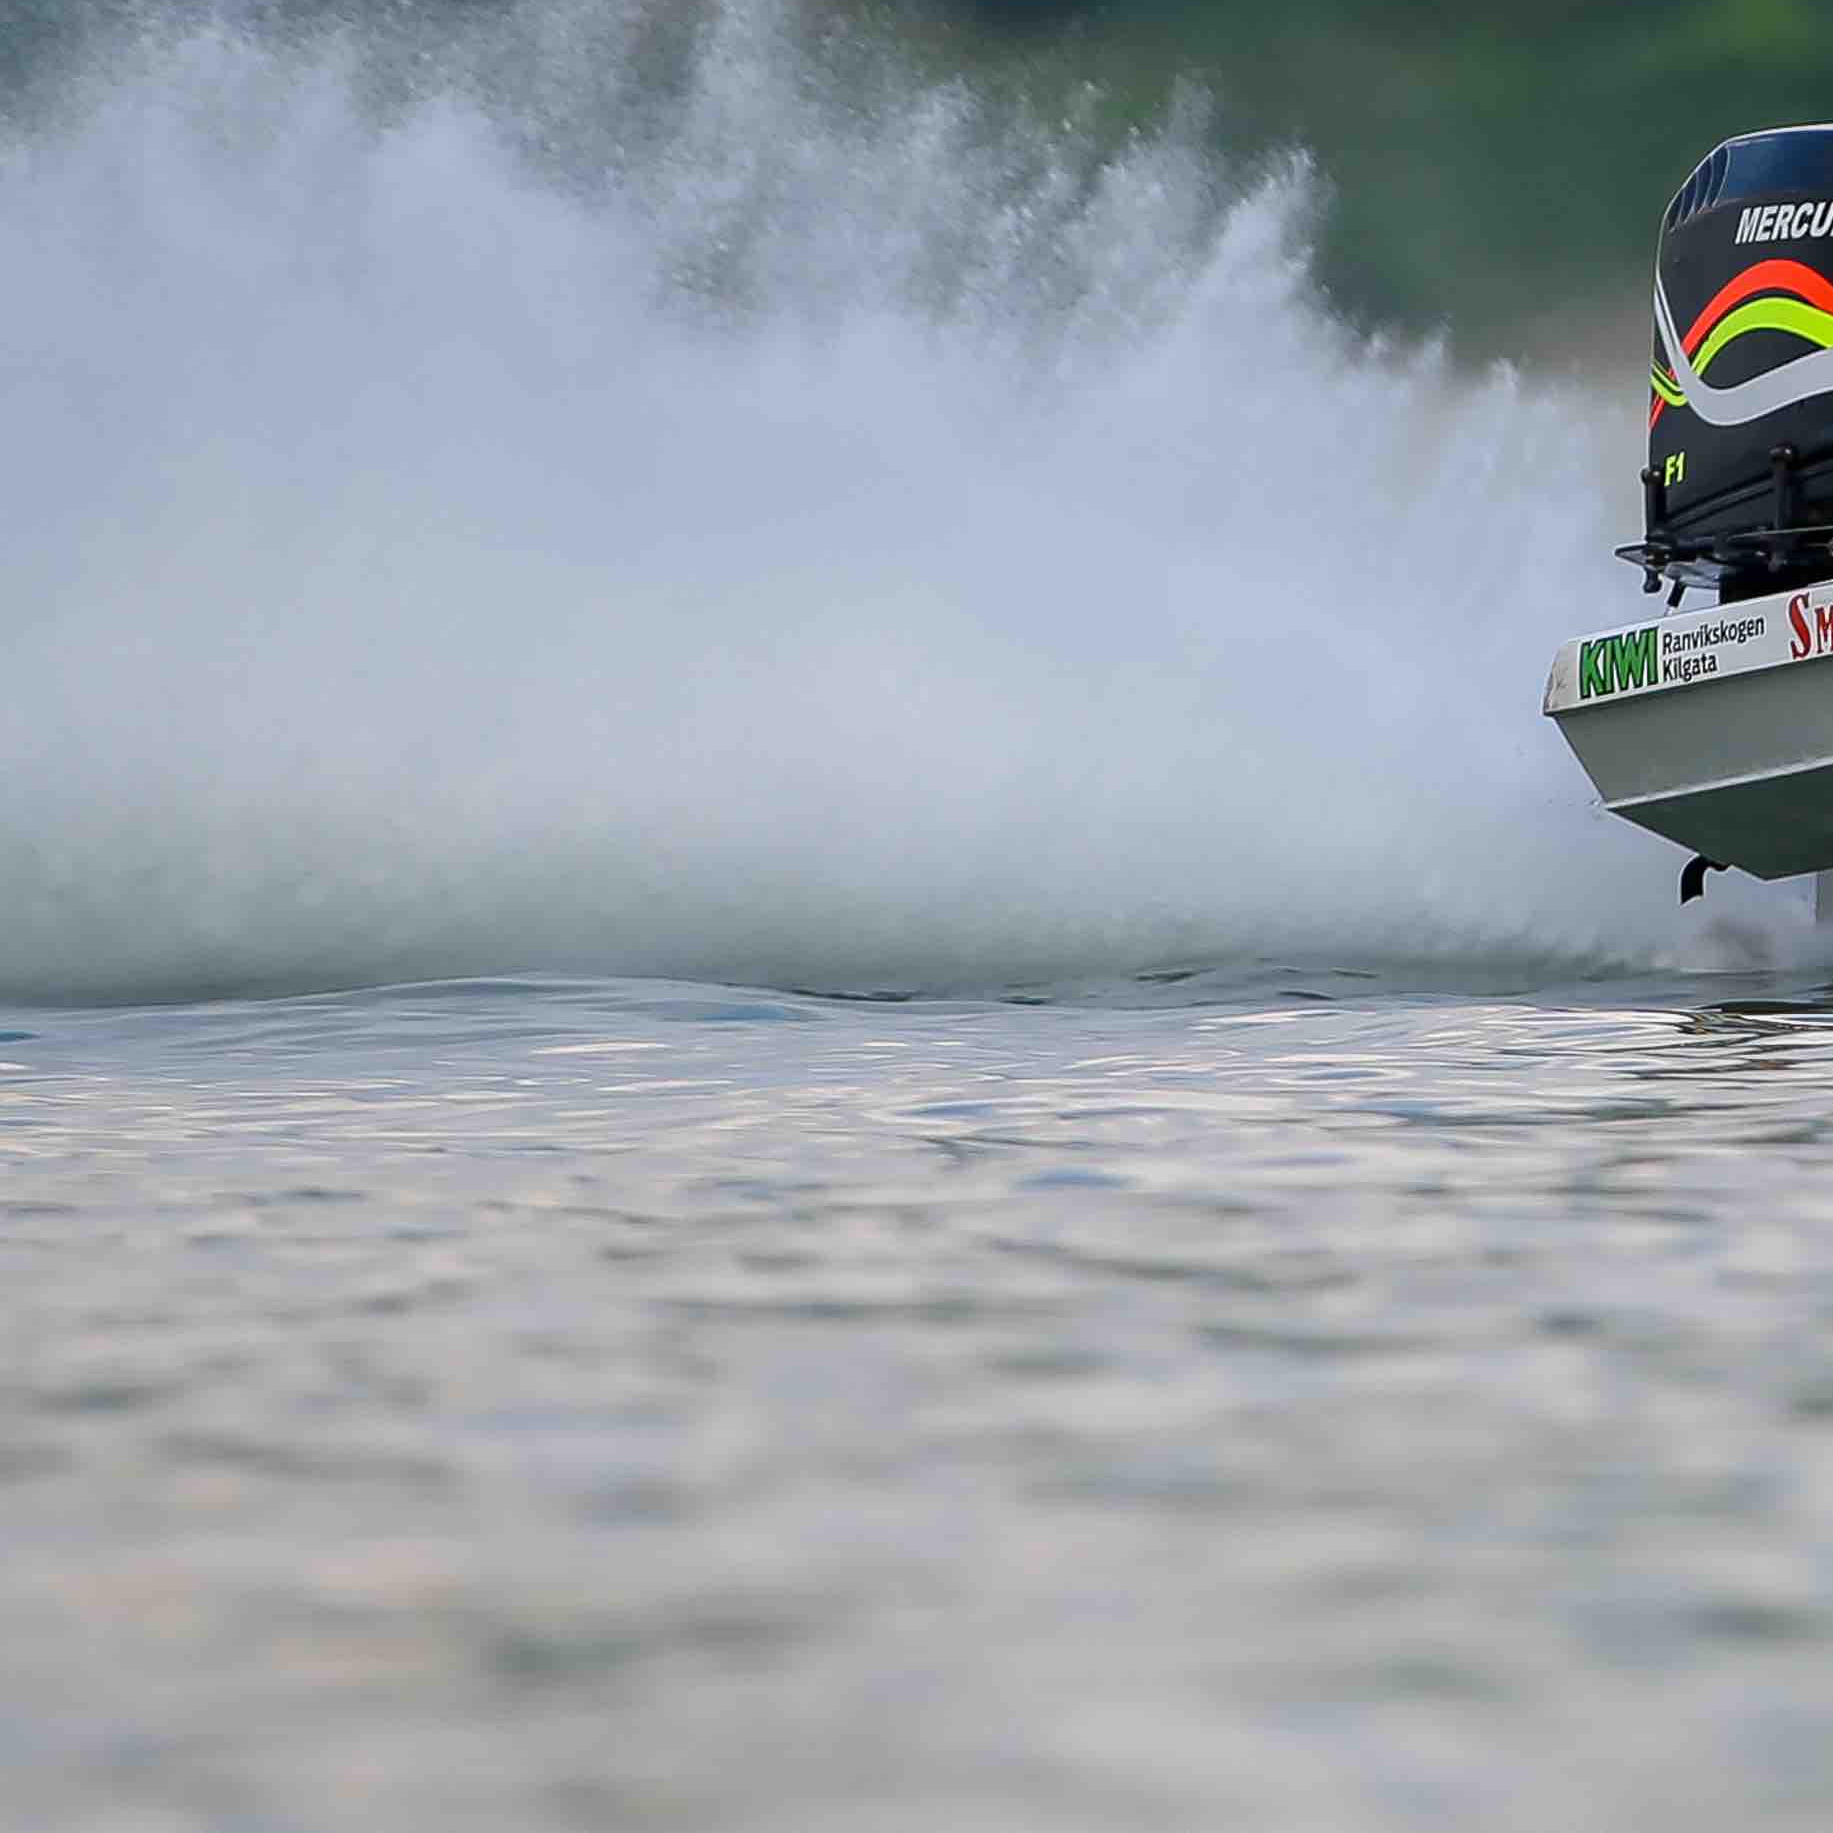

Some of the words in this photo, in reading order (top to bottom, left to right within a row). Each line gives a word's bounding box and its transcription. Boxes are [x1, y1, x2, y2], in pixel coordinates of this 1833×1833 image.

[1664, 452, 1686, 487] F1
[1661, 616, 1765, 656] Ranvikskogen
[1579, 625, 1660, 700] KIWI
[1661, 652, 1718, 683] Kilgata
